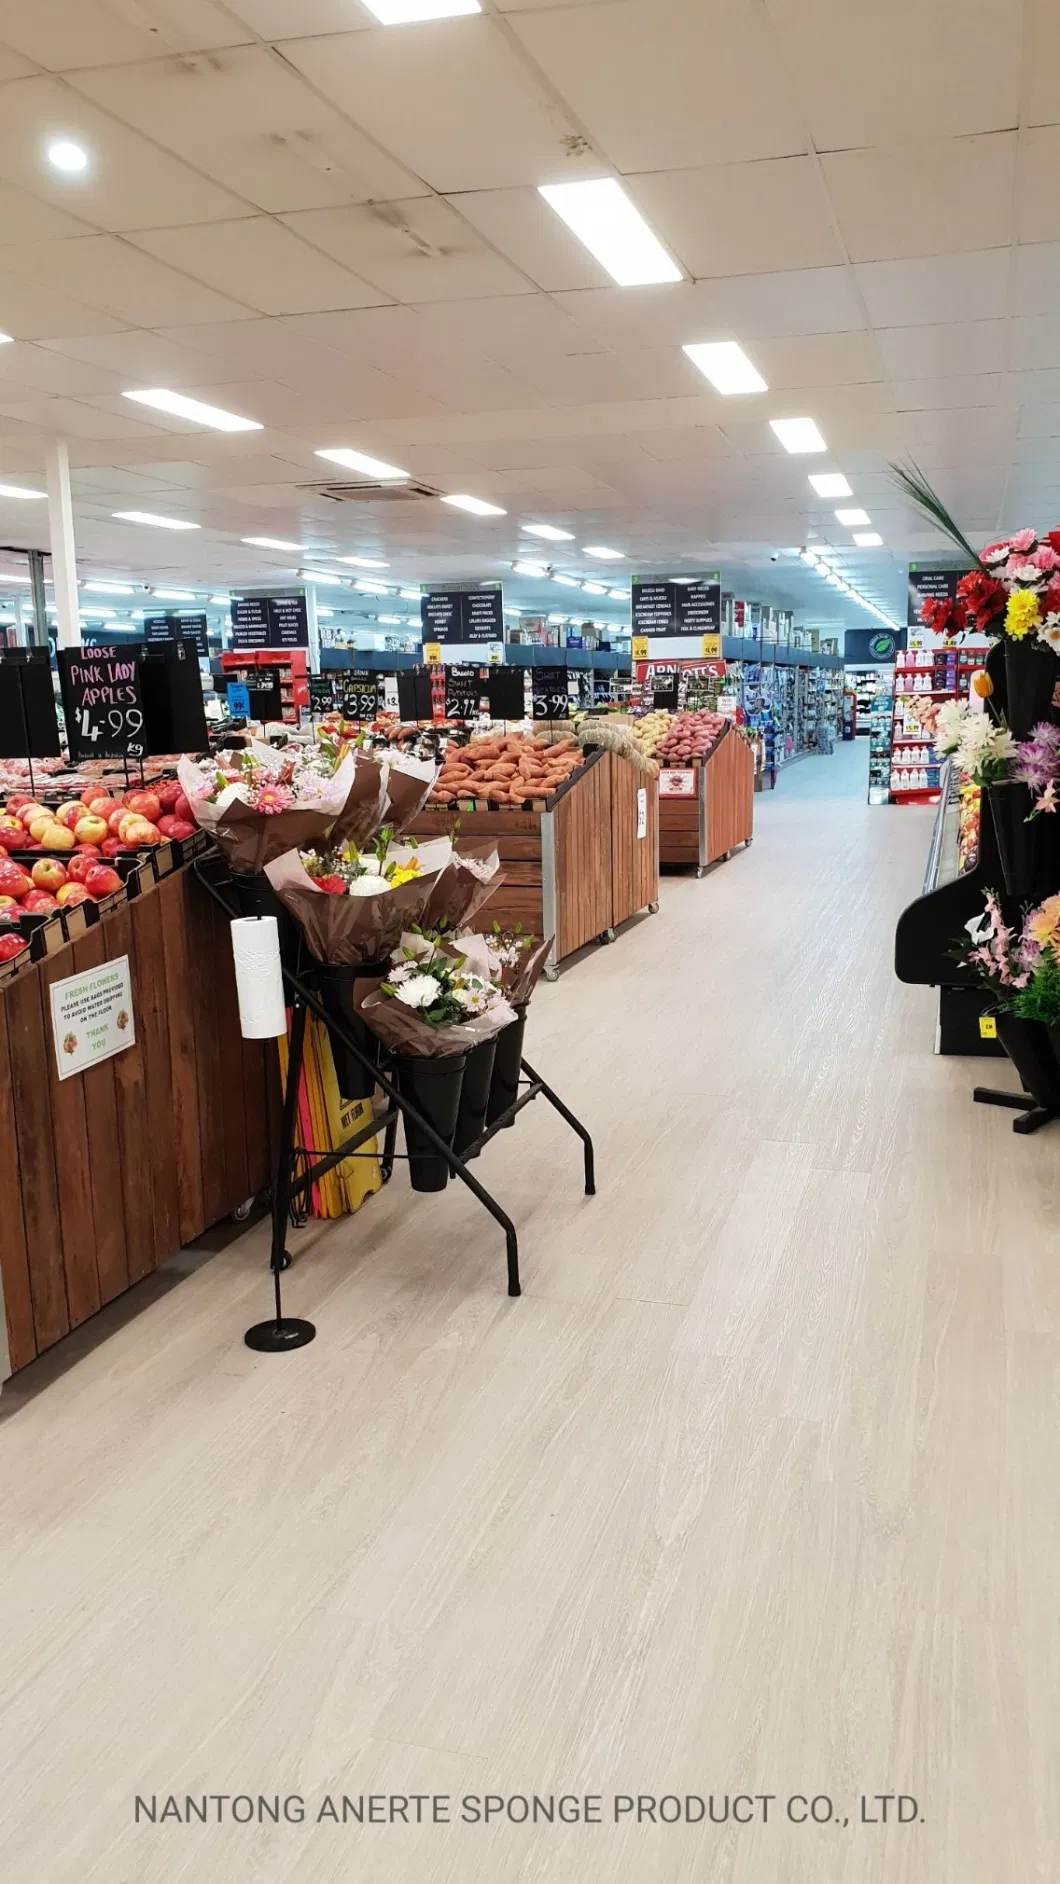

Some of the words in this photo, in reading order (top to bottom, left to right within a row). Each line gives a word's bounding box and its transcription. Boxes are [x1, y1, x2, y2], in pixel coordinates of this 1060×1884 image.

[81, 646, 117, 660] LOOSE
[70, 665, 104, 686] PINK
[107, 661, 135, 683] LADY
[535, 668, 560, 681] SWEET
[344, 679, 376, 693] CAPSICUM
[448, 678, 472, 687] SWEET
[82, 685, 136, 706] APPLES
[65, 985, 88, 1000] FRESH
[90, 973, 119, 990] FLOWERS
[61, 1002, 79, 1012] PLEASE
[90, 992, 102, 1001] BAGS
[103, 982, 124, 996] PROVIDED
[72, 1007, 86, 1016] AVOID
[88, 1002, 103, 1011] WATER
[103, 992, 123, 1006] DRIPPING
[98, 1005, 112, 1016] FLOOR
[87, 1024, 109, 1039] THANK
[92, 1040, 106, 1050] YOU
